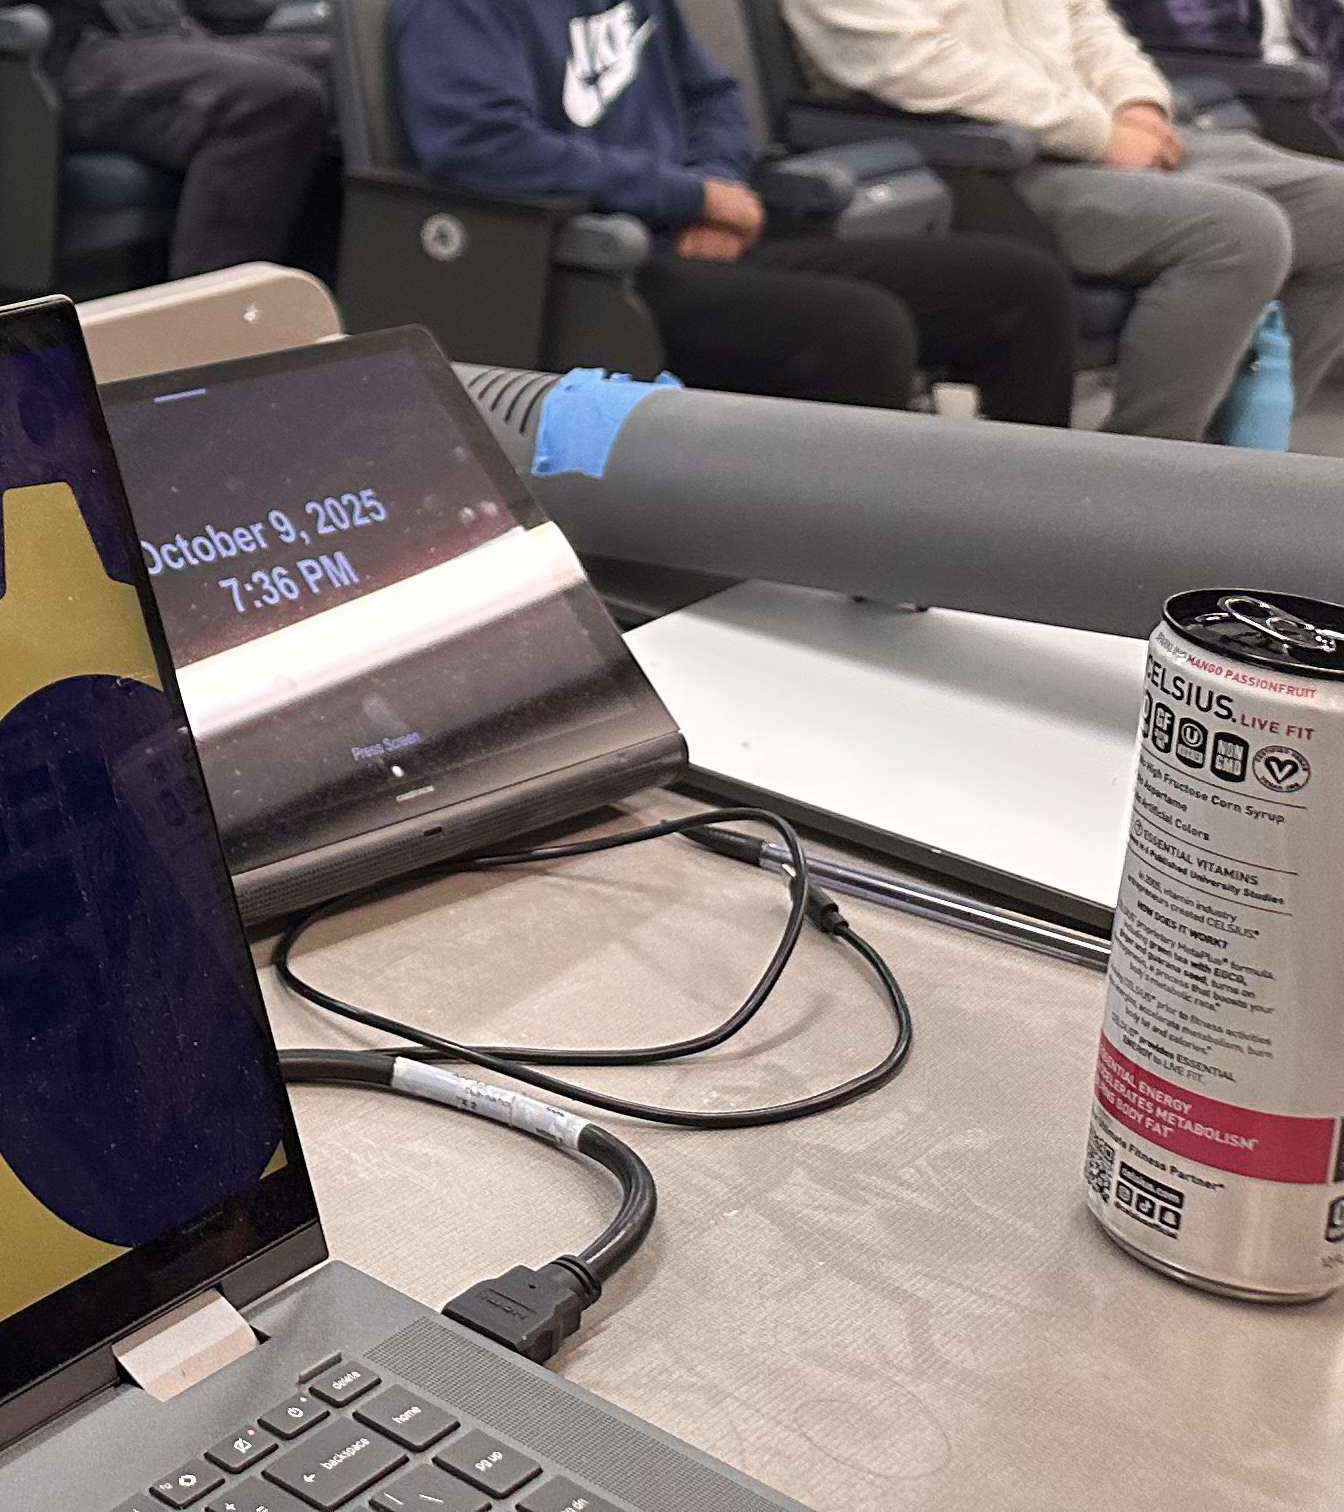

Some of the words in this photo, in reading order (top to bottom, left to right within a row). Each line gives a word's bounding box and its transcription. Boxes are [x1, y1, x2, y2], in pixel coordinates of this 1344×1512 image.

[140, 524, 268, 575] October
[268, 508, 311, 546] 9,
[305, 488, 387, 535] 2025
[218, 565, 300, 614] 7:36
[297, 550, 360, 595] PM
[1186, 653, 1224, 676] MANGO
[1223, 668, 1319, 699] PASSIONFRUIT
[1239, 713, 1281, 735] LIVE
[1285, 724, 1316, 740] FIT
[1210, 795, 1244, 813] Corn
[1243, 805, 1286, 825] Syrup
[1174, 818, 1211, 841] Colors
[1195, 857, 1260, 887] VITAMINS
[1138, 1081, 1193, 1115] ENERGY
[391, 1405, 422, 1426] home
[319, 1436, 371, 1471] backspace
[488, 1450, 504, 1466] up
